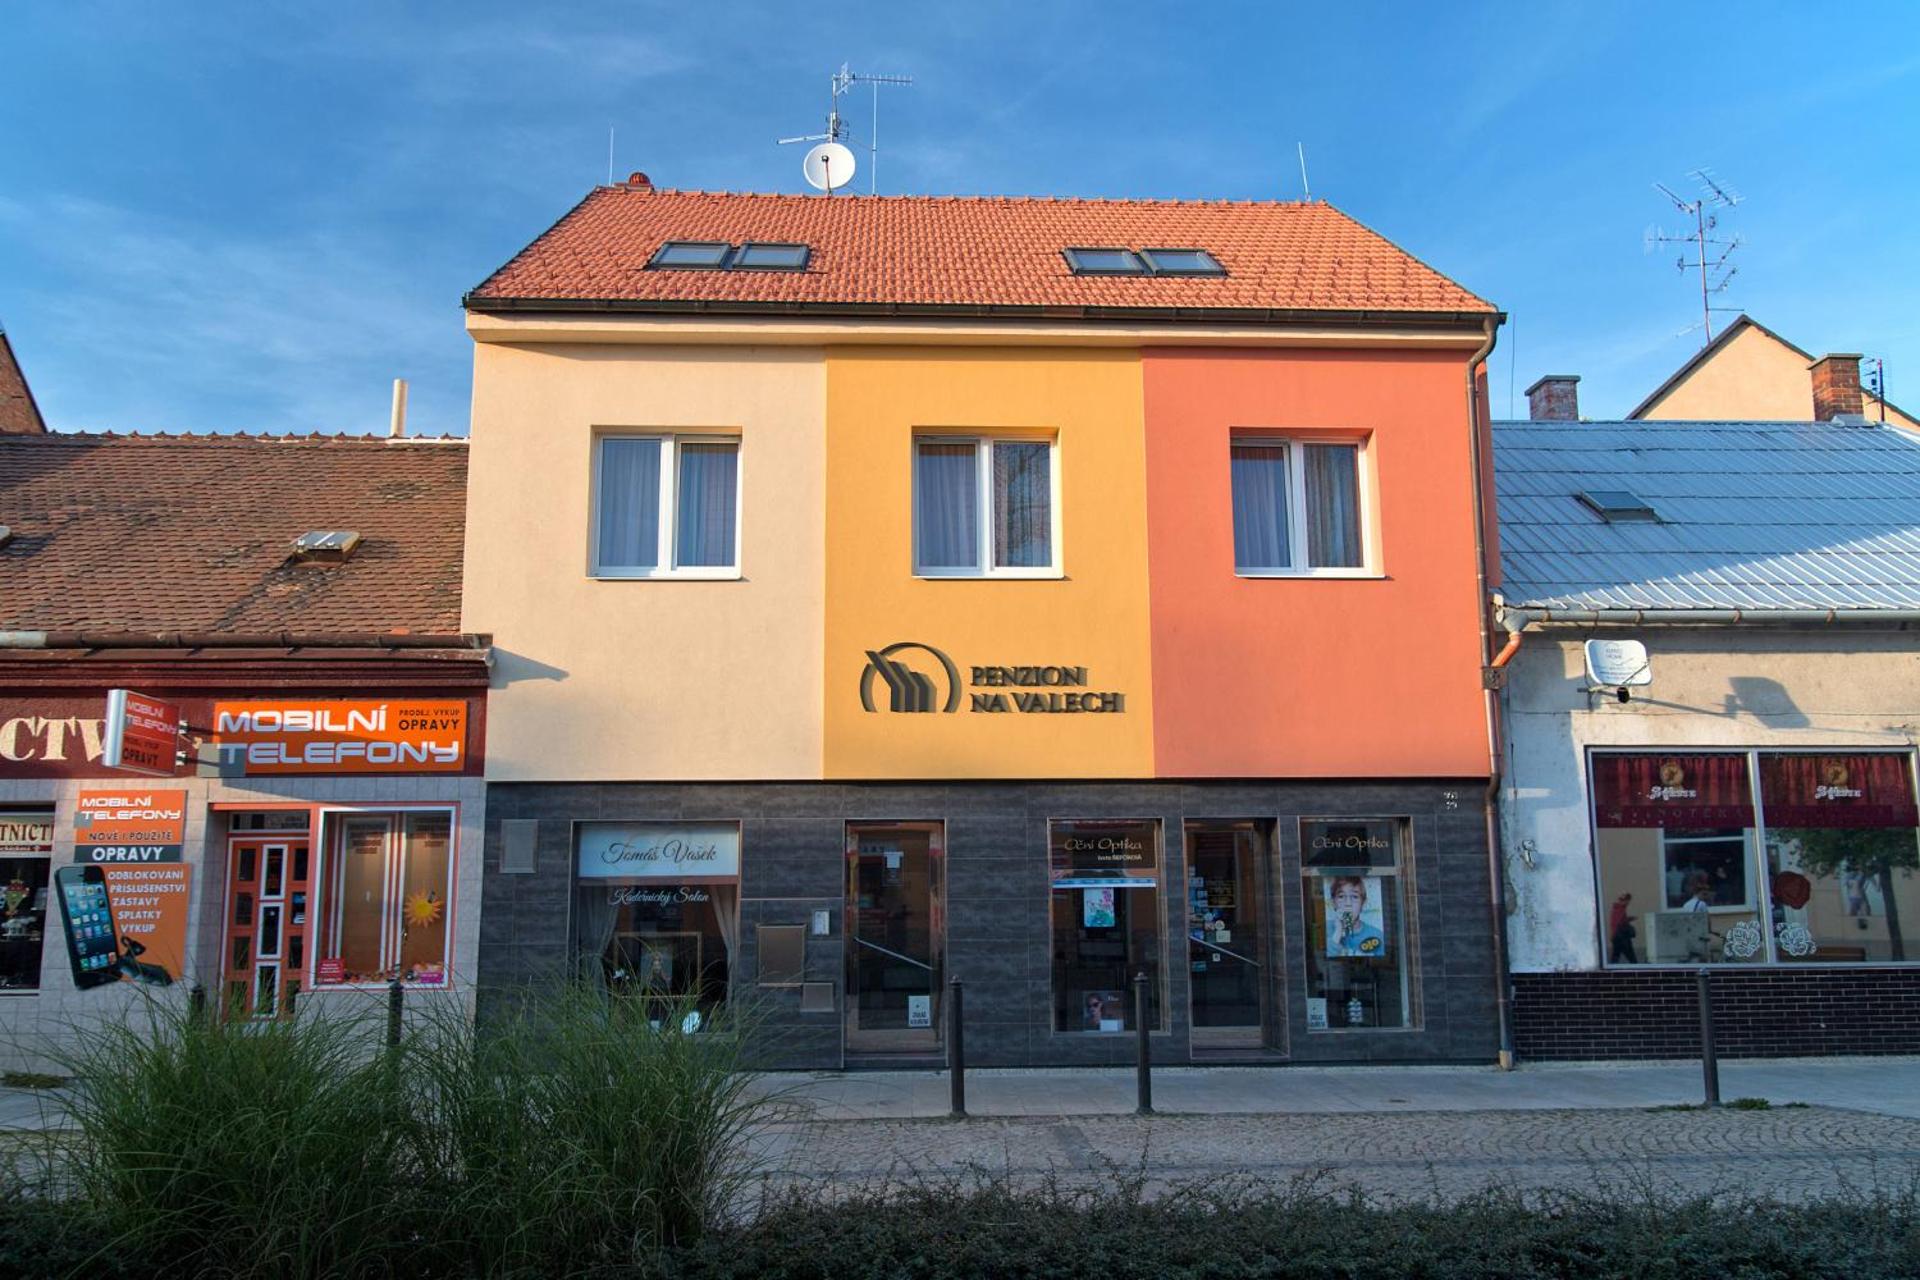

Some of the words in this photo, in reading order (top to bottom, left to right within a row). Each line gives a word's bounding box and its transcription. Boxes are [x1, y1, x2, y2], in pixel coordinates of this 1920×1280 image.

[970, 665, 1087, 686] PENZION
[970, 693, 1009, 712] NA
[1011, 692, 1125, 713] VALECH
[219, 705, 388, 733] MOBILNÍ
[398, 719, 460, 731] OPRAVY
[217, 741, 460, 764] TELEFONY
[81, 796, 152, 807] MOBILNÍ
[81, 810, 181, 820] TELEFONY
[1064, 838, 1095, 851] Oční
[1097, 837, 1143, 853] Optika
[1345, 835, 1390, 852] Optika
[92, 847, 164, 861] OPRAVY
[601, 842, 658, 864] Tomáš
[673, 886, 710, 903] Salon
